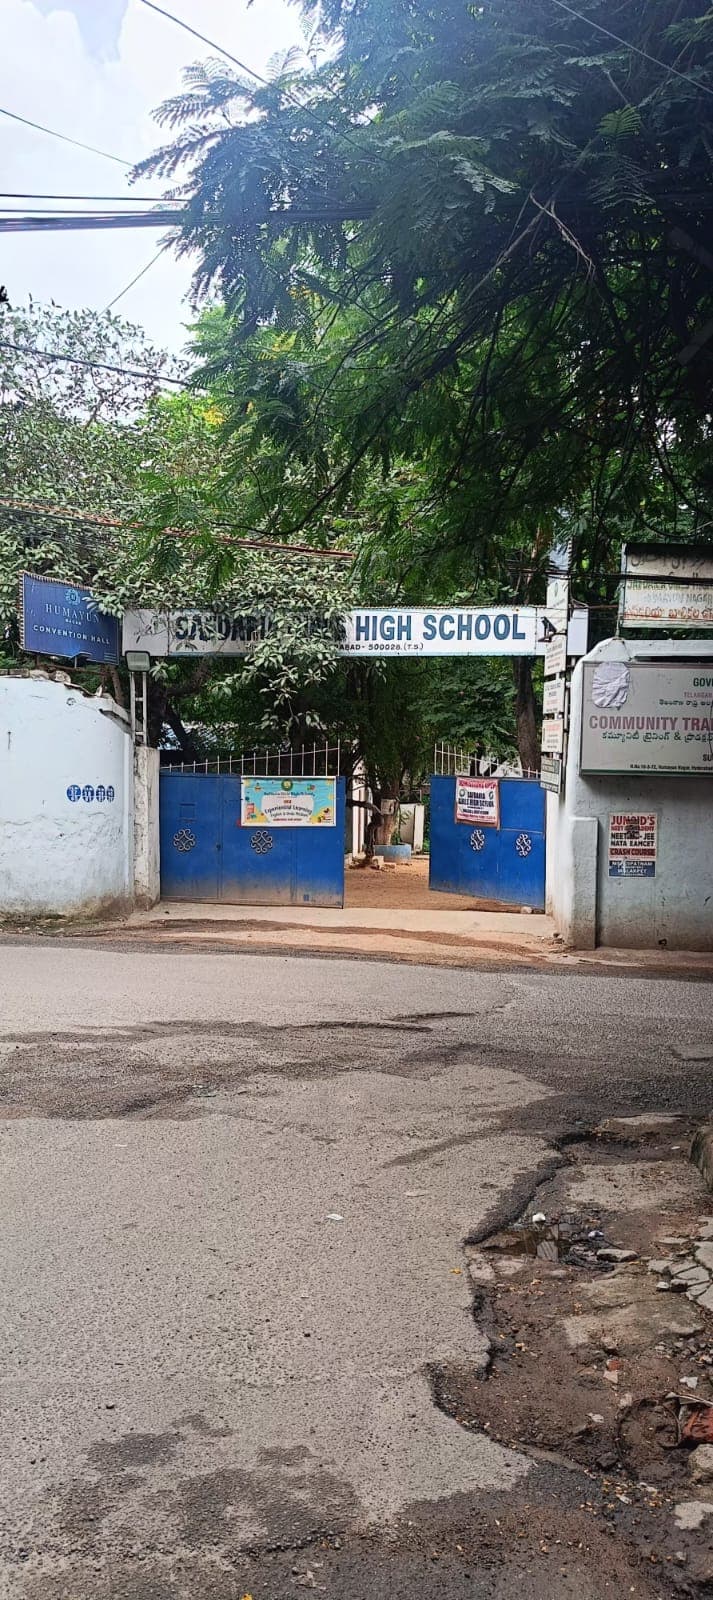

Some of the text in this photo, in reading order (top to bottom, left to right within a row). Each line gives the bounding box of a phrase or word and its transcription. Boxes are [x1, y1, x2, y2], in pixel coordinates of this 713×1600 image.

[33, 624, 110, 645] CONVENTION HALL
[355, 614, 412, 641] HIGH
[422, 613, 526, 641] SCHOOL
[589, 715, 678, 731] COMMUNITY
[674, 732, 682, 741] &
[610, 848, 656, 857] CRASH COURSE
